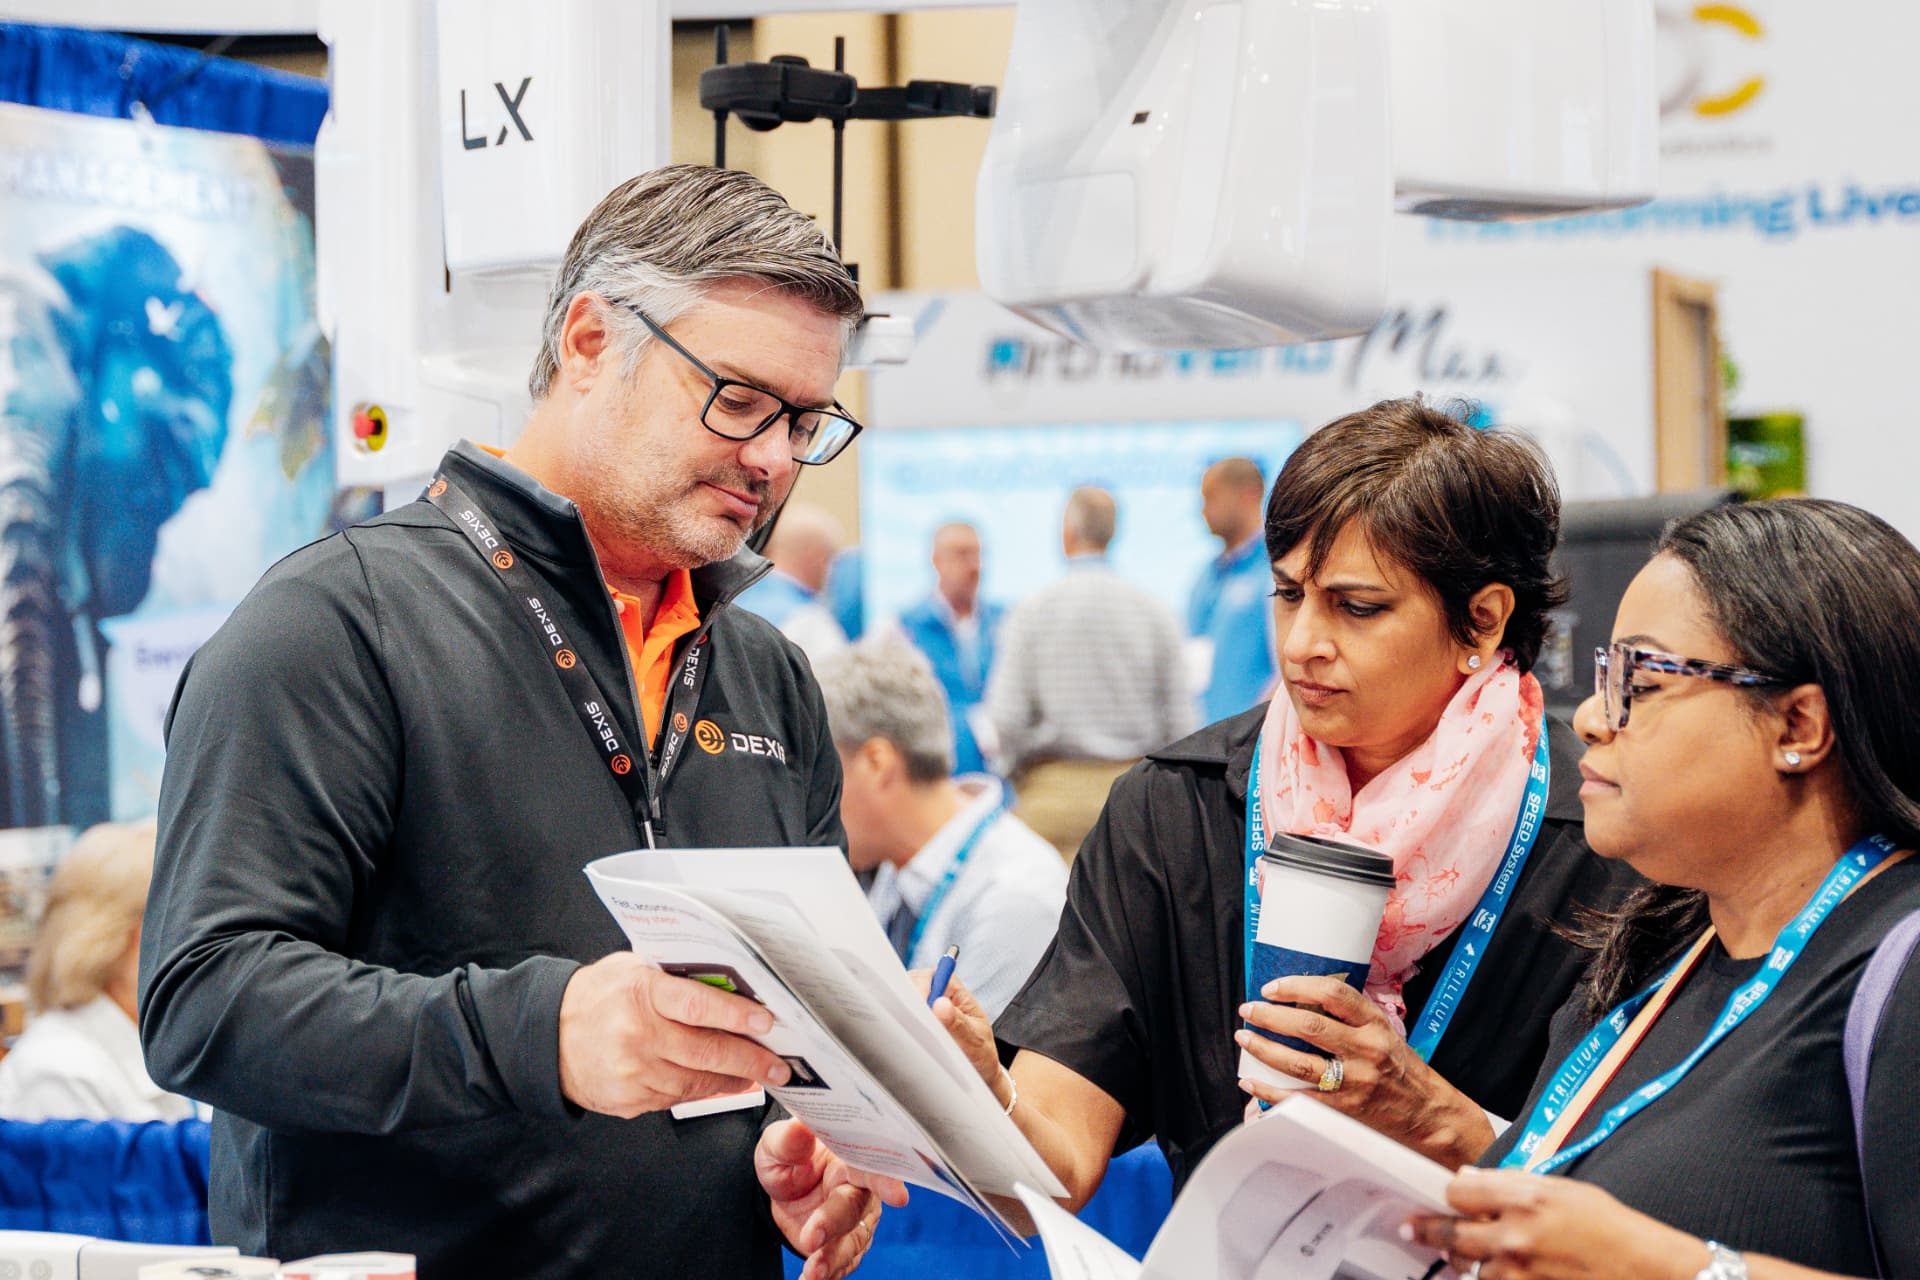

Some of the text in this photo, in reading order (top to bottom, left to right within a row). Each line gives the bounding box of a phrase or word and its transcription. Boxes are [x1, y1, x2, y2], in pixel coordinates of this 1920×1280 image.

[461, 76, 534, 150] LX
[461, 510, 499, 549] DEXIS
[529, 597, 563, 646] DEXIS
[684, 647, 700, 687] DEXIS
[586, 701, 619, 752] DEXIS
[661, 732, 679, 778] DEXIS
[1251, 801, 1265, 851] SPEED
[1518, 792, 1541, 842] SPEED
[1494, 843, 1525, 896] System
[1798, 867, 1860, 935] TRILLIUM
[1428, 960, 1471, 1033] TRILLIUM
[1727, 980, 1768, 1026] SPEED
[1548, 1037, 1601, 1105] TRILLIUM
